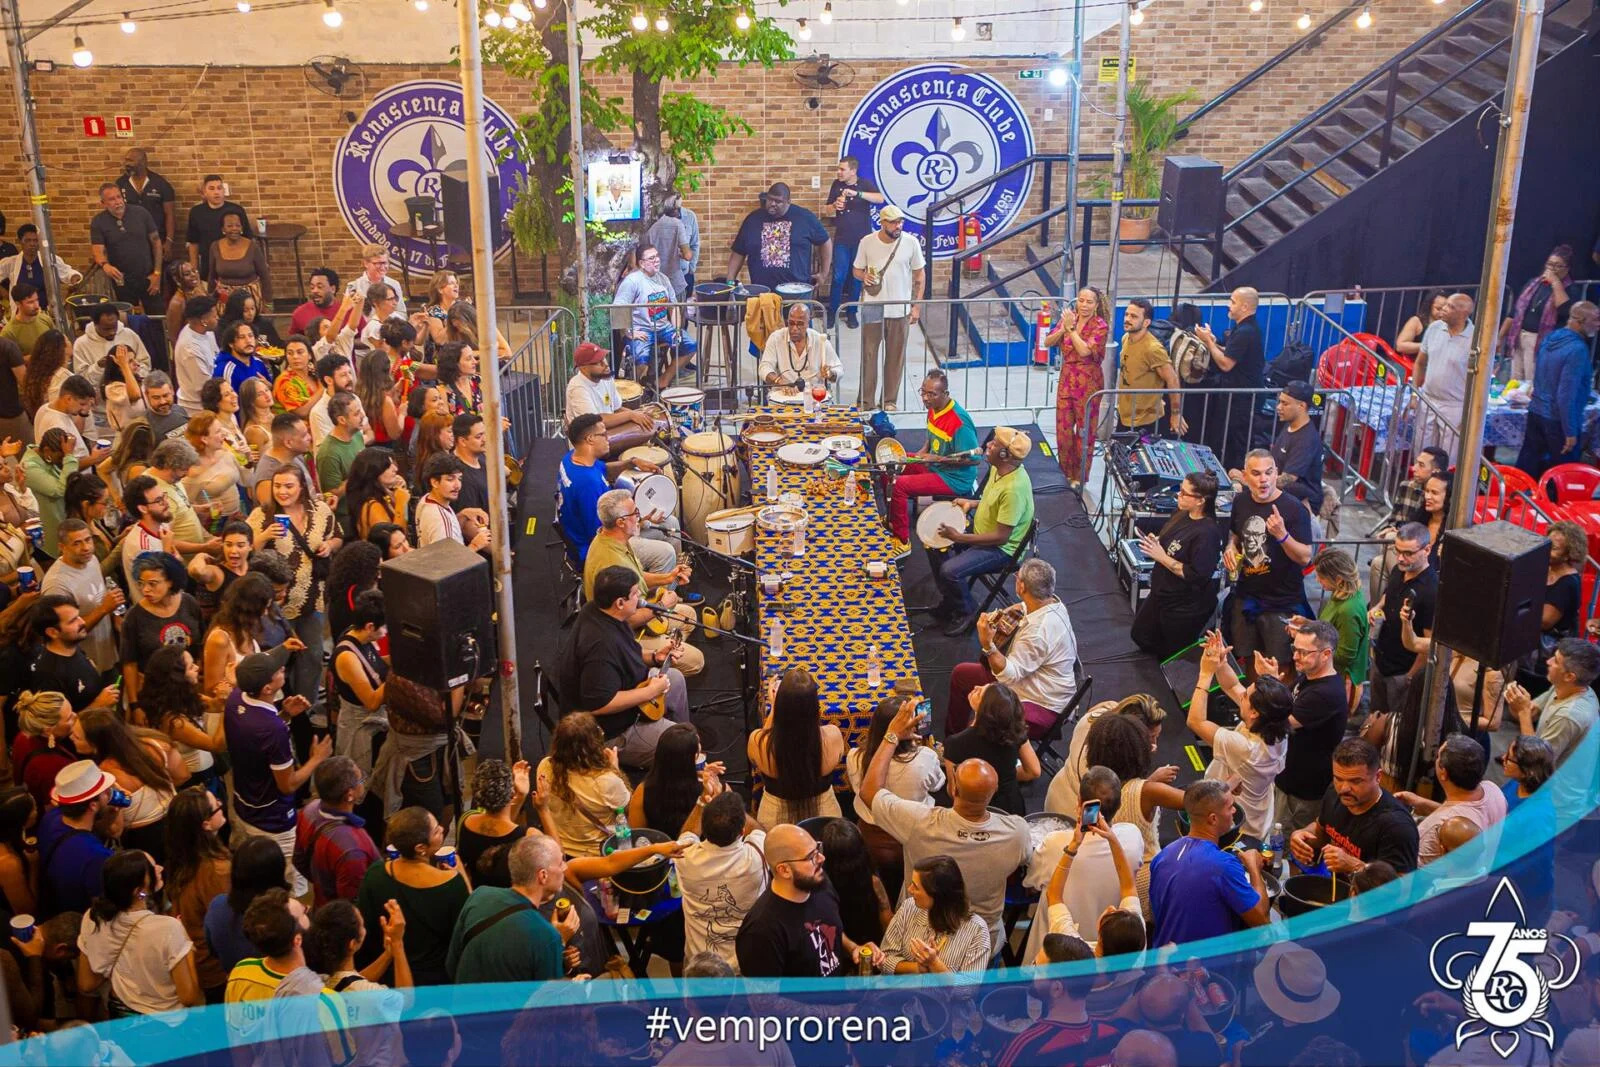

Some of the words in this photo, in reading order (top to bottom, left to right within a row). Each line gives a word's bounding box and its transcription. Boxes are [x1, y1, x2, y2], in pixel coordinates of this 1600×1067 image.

[346, 96, 460, 162] Renascença
[853, 78, 969, 145] Renascença
[972, 85, 1016, 143] Clube
[923, 159, 951, 185] RC
[351, 206, 391, 250] Fundado
[410, 250, 422, 263] 17
[984, 213, 999, 227] de
[995, 188, 1015, 217] 1951
